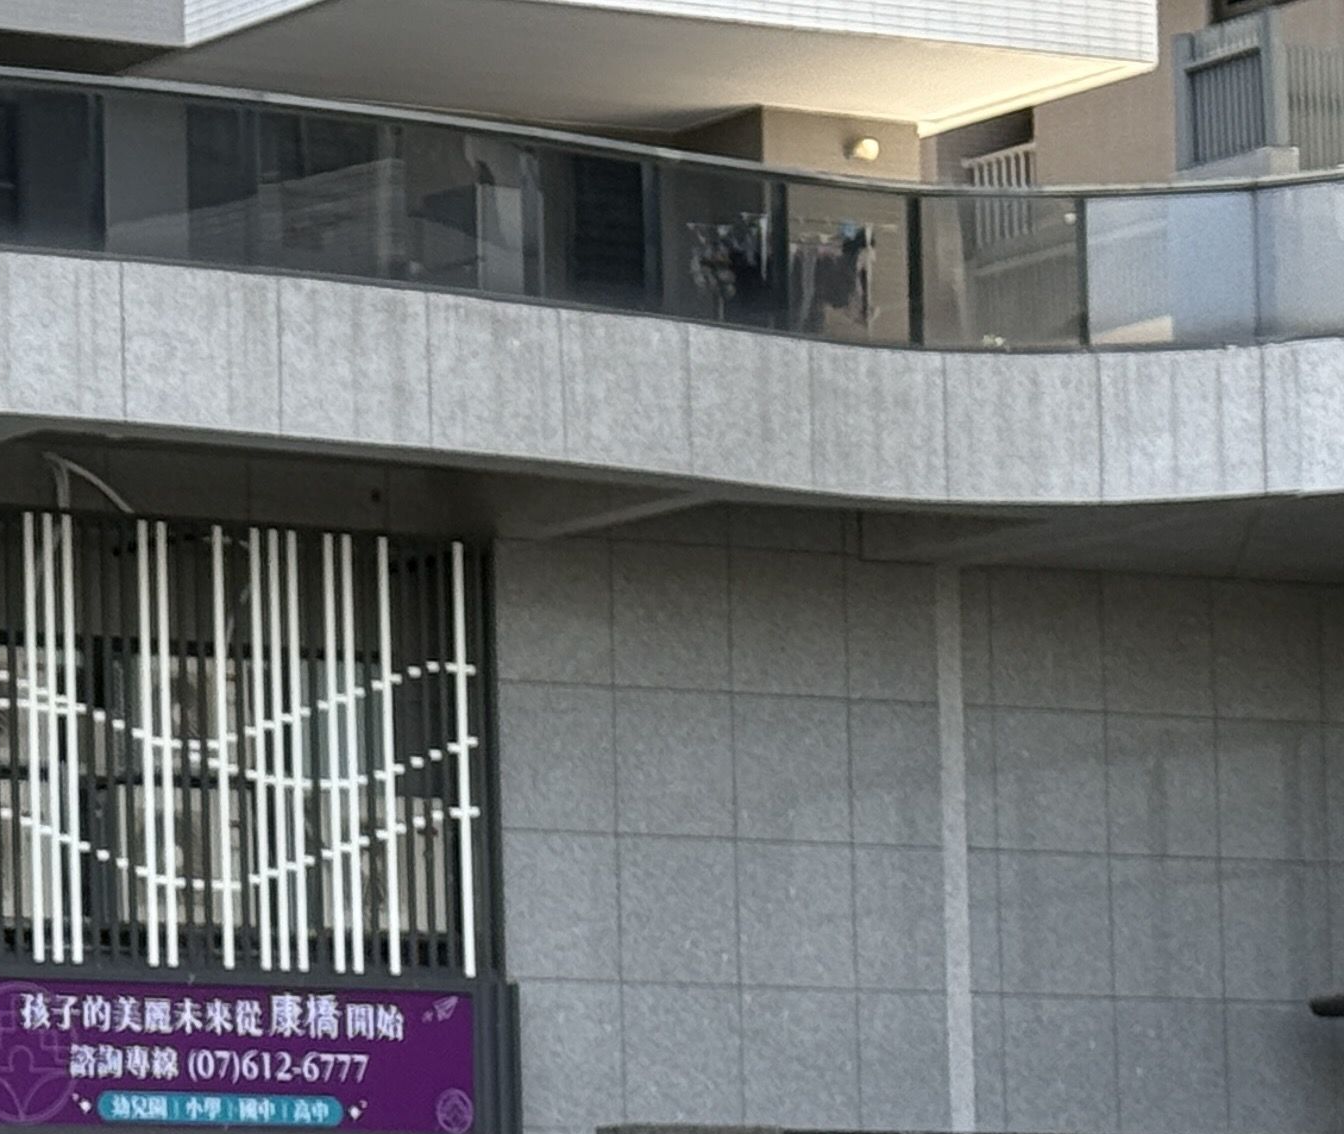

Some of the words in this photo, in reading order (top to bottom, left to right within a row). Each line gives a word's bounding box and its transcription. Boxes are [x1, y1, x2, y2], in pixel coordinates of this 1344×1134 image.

[69, 1044, 179, 1080] 諮詢專線
[188, 1048, 370, 1083] (07)612-6777
